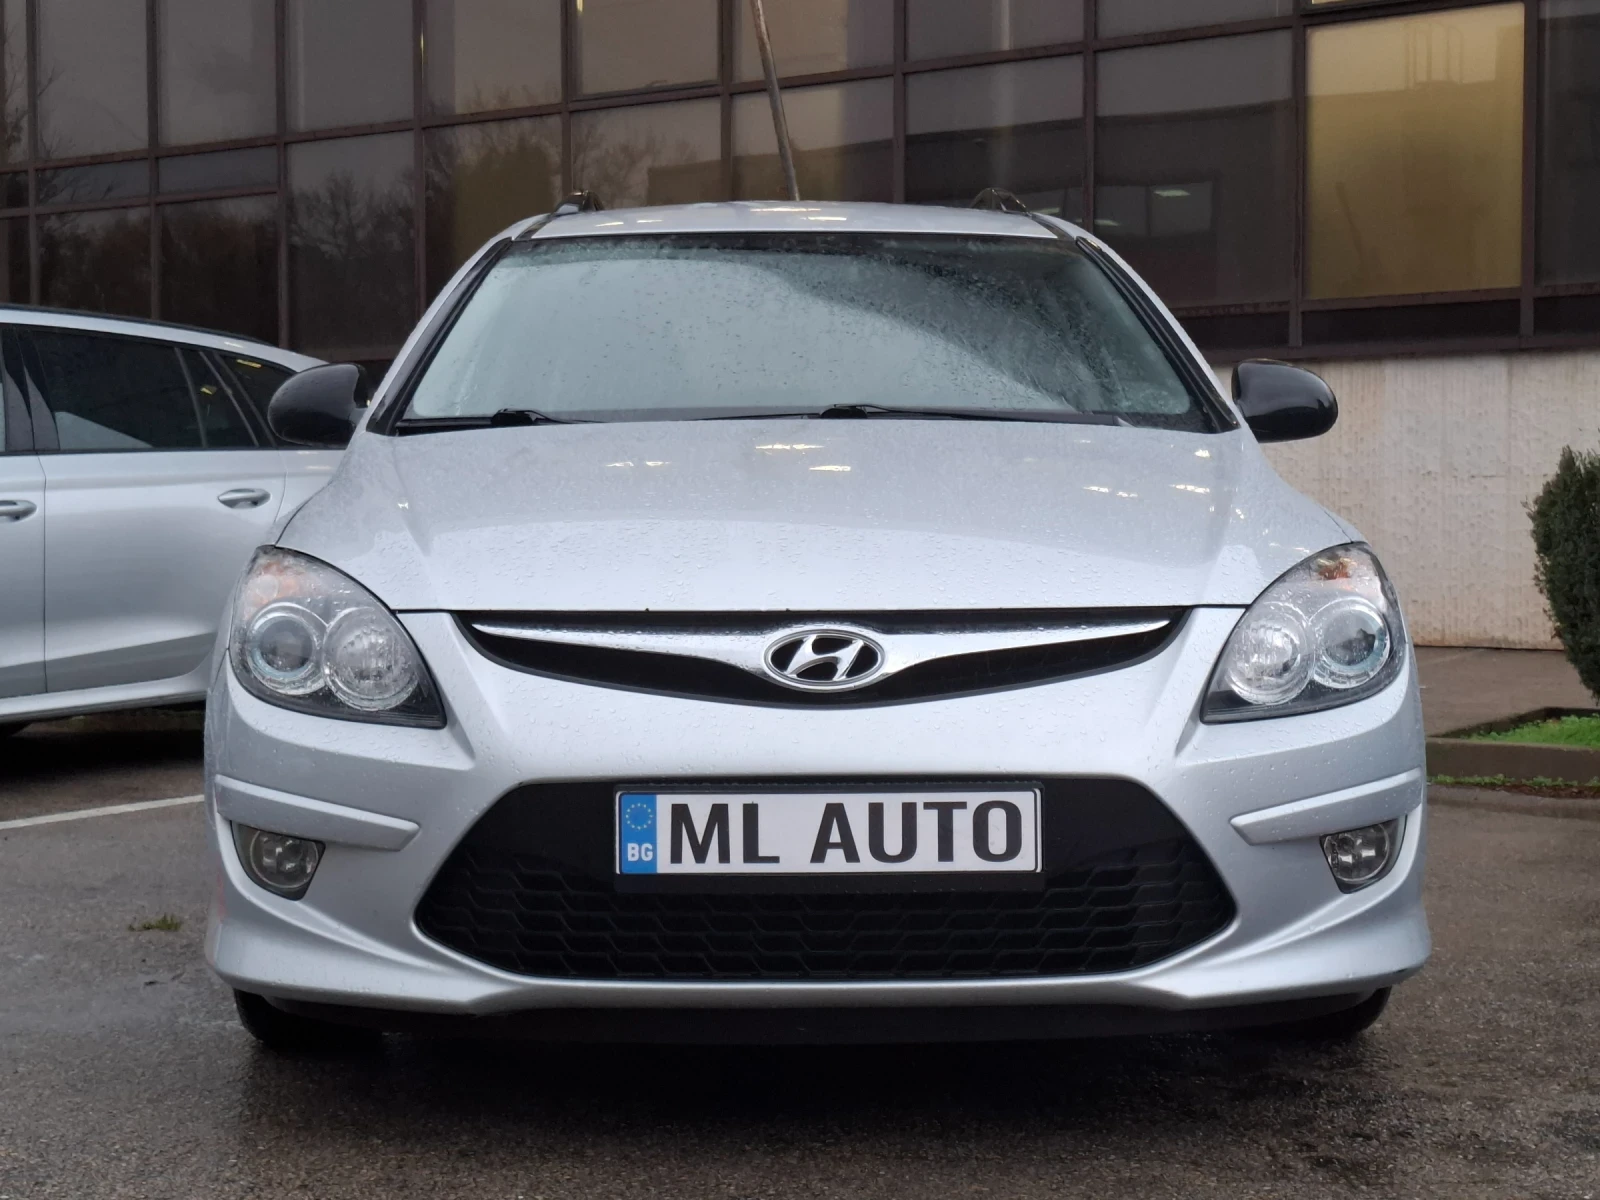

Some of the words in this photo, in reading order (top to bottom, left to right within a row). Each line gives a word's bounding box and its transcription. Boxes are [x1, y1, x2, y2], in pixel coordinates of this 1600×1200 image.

[627, 843, 653, 861] BG
[669, 802, 780, 864] ML
[809, 800, 1022, 864] AUTO
